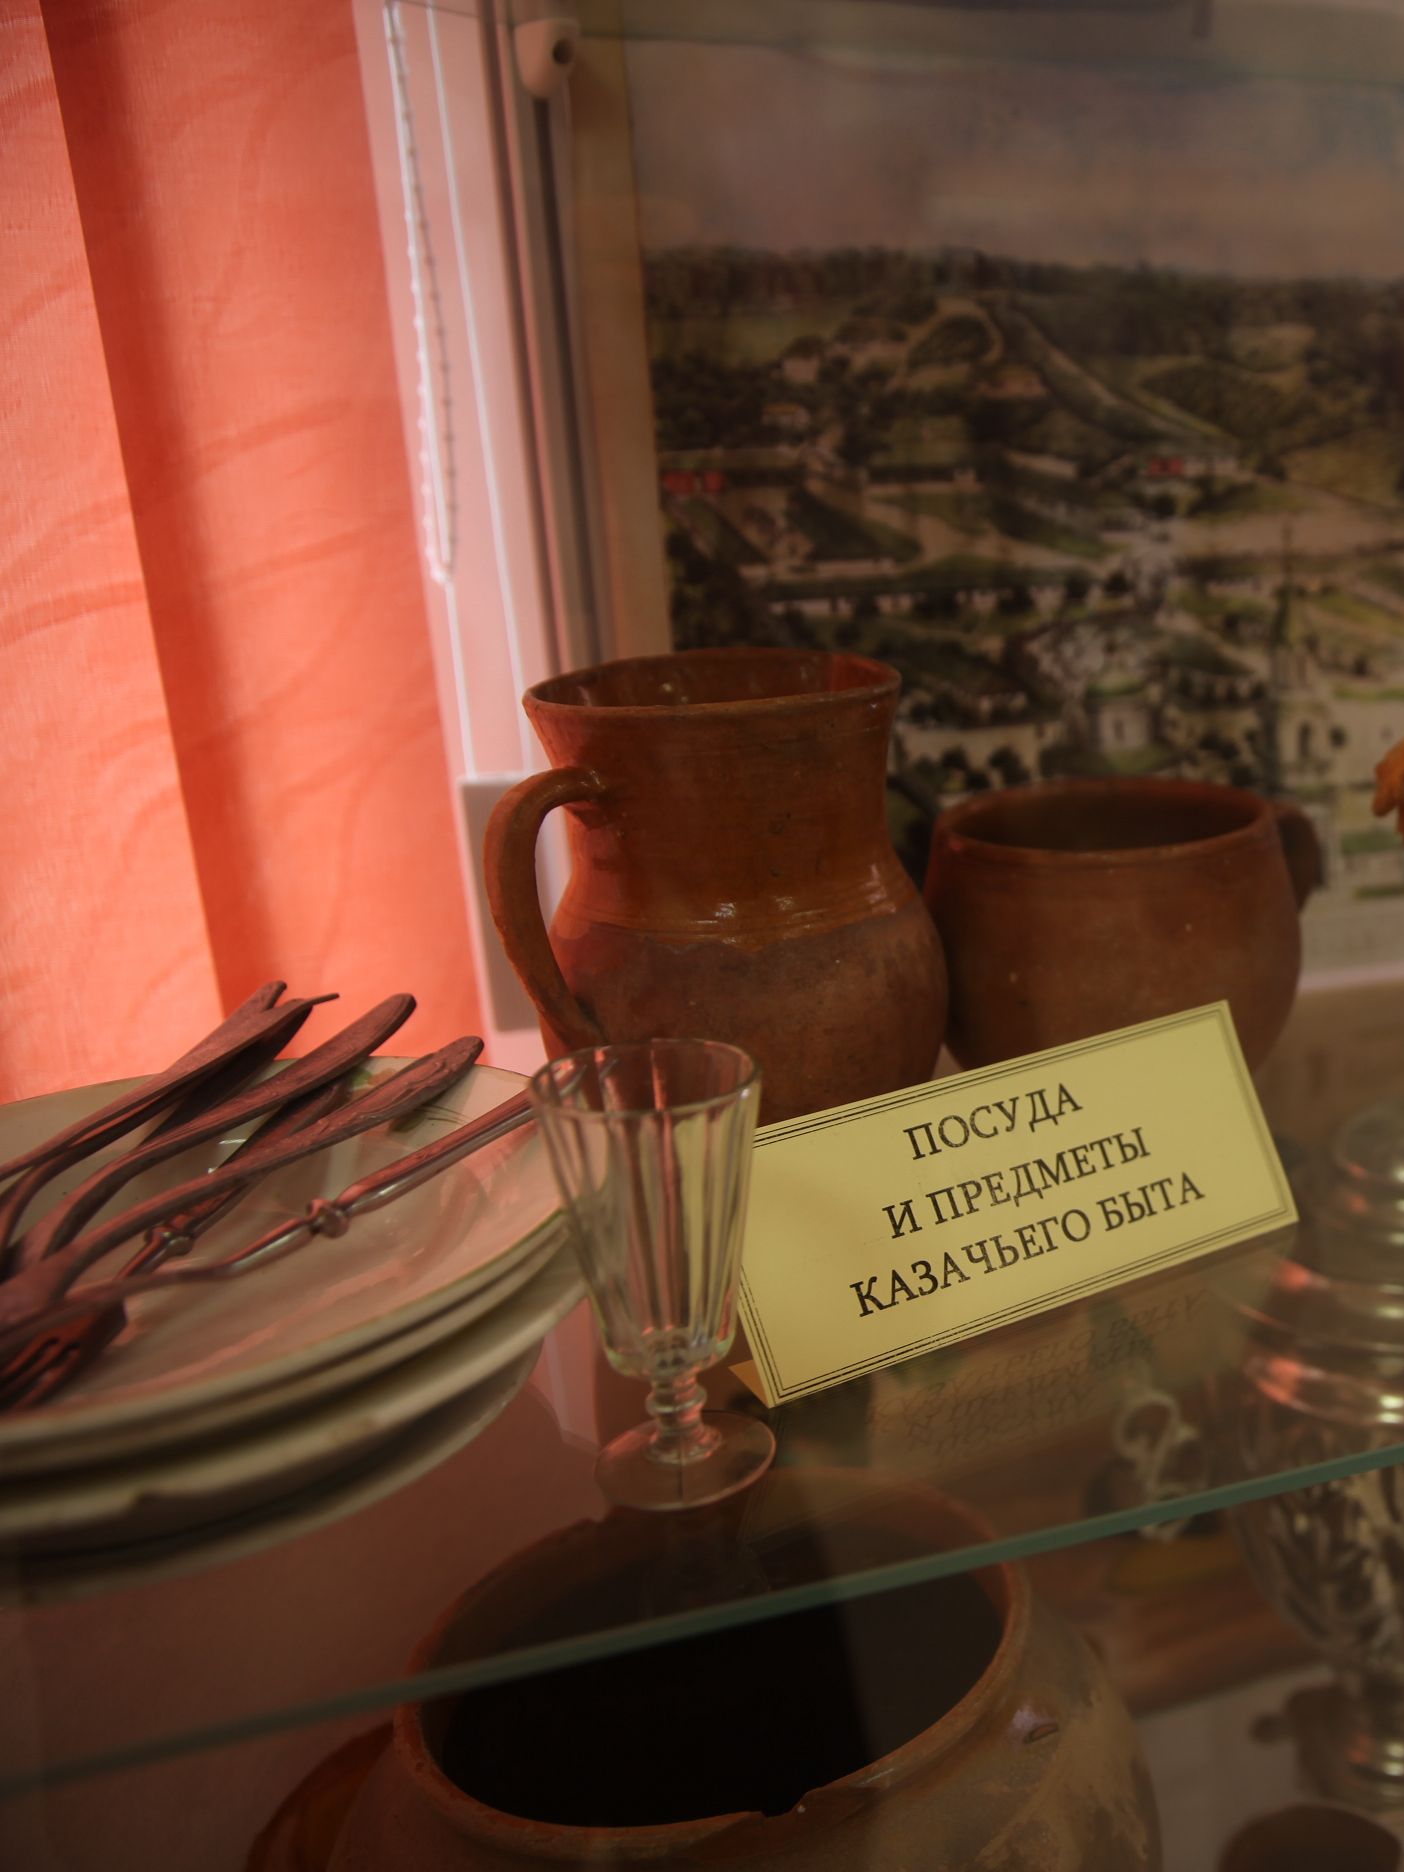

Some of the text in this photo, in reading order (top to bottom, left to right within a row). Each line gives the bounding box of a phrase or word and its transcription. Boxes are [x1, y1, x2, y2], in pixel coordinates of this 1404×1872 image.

[902, 1082, 1084, 1161] ПОСУДА
[881, 1127, 1152, 1240] И ПРЕДМЕТЫ
[849, 1171, 1206, 1318] КАЗАЧЬЕГО БЫТА
